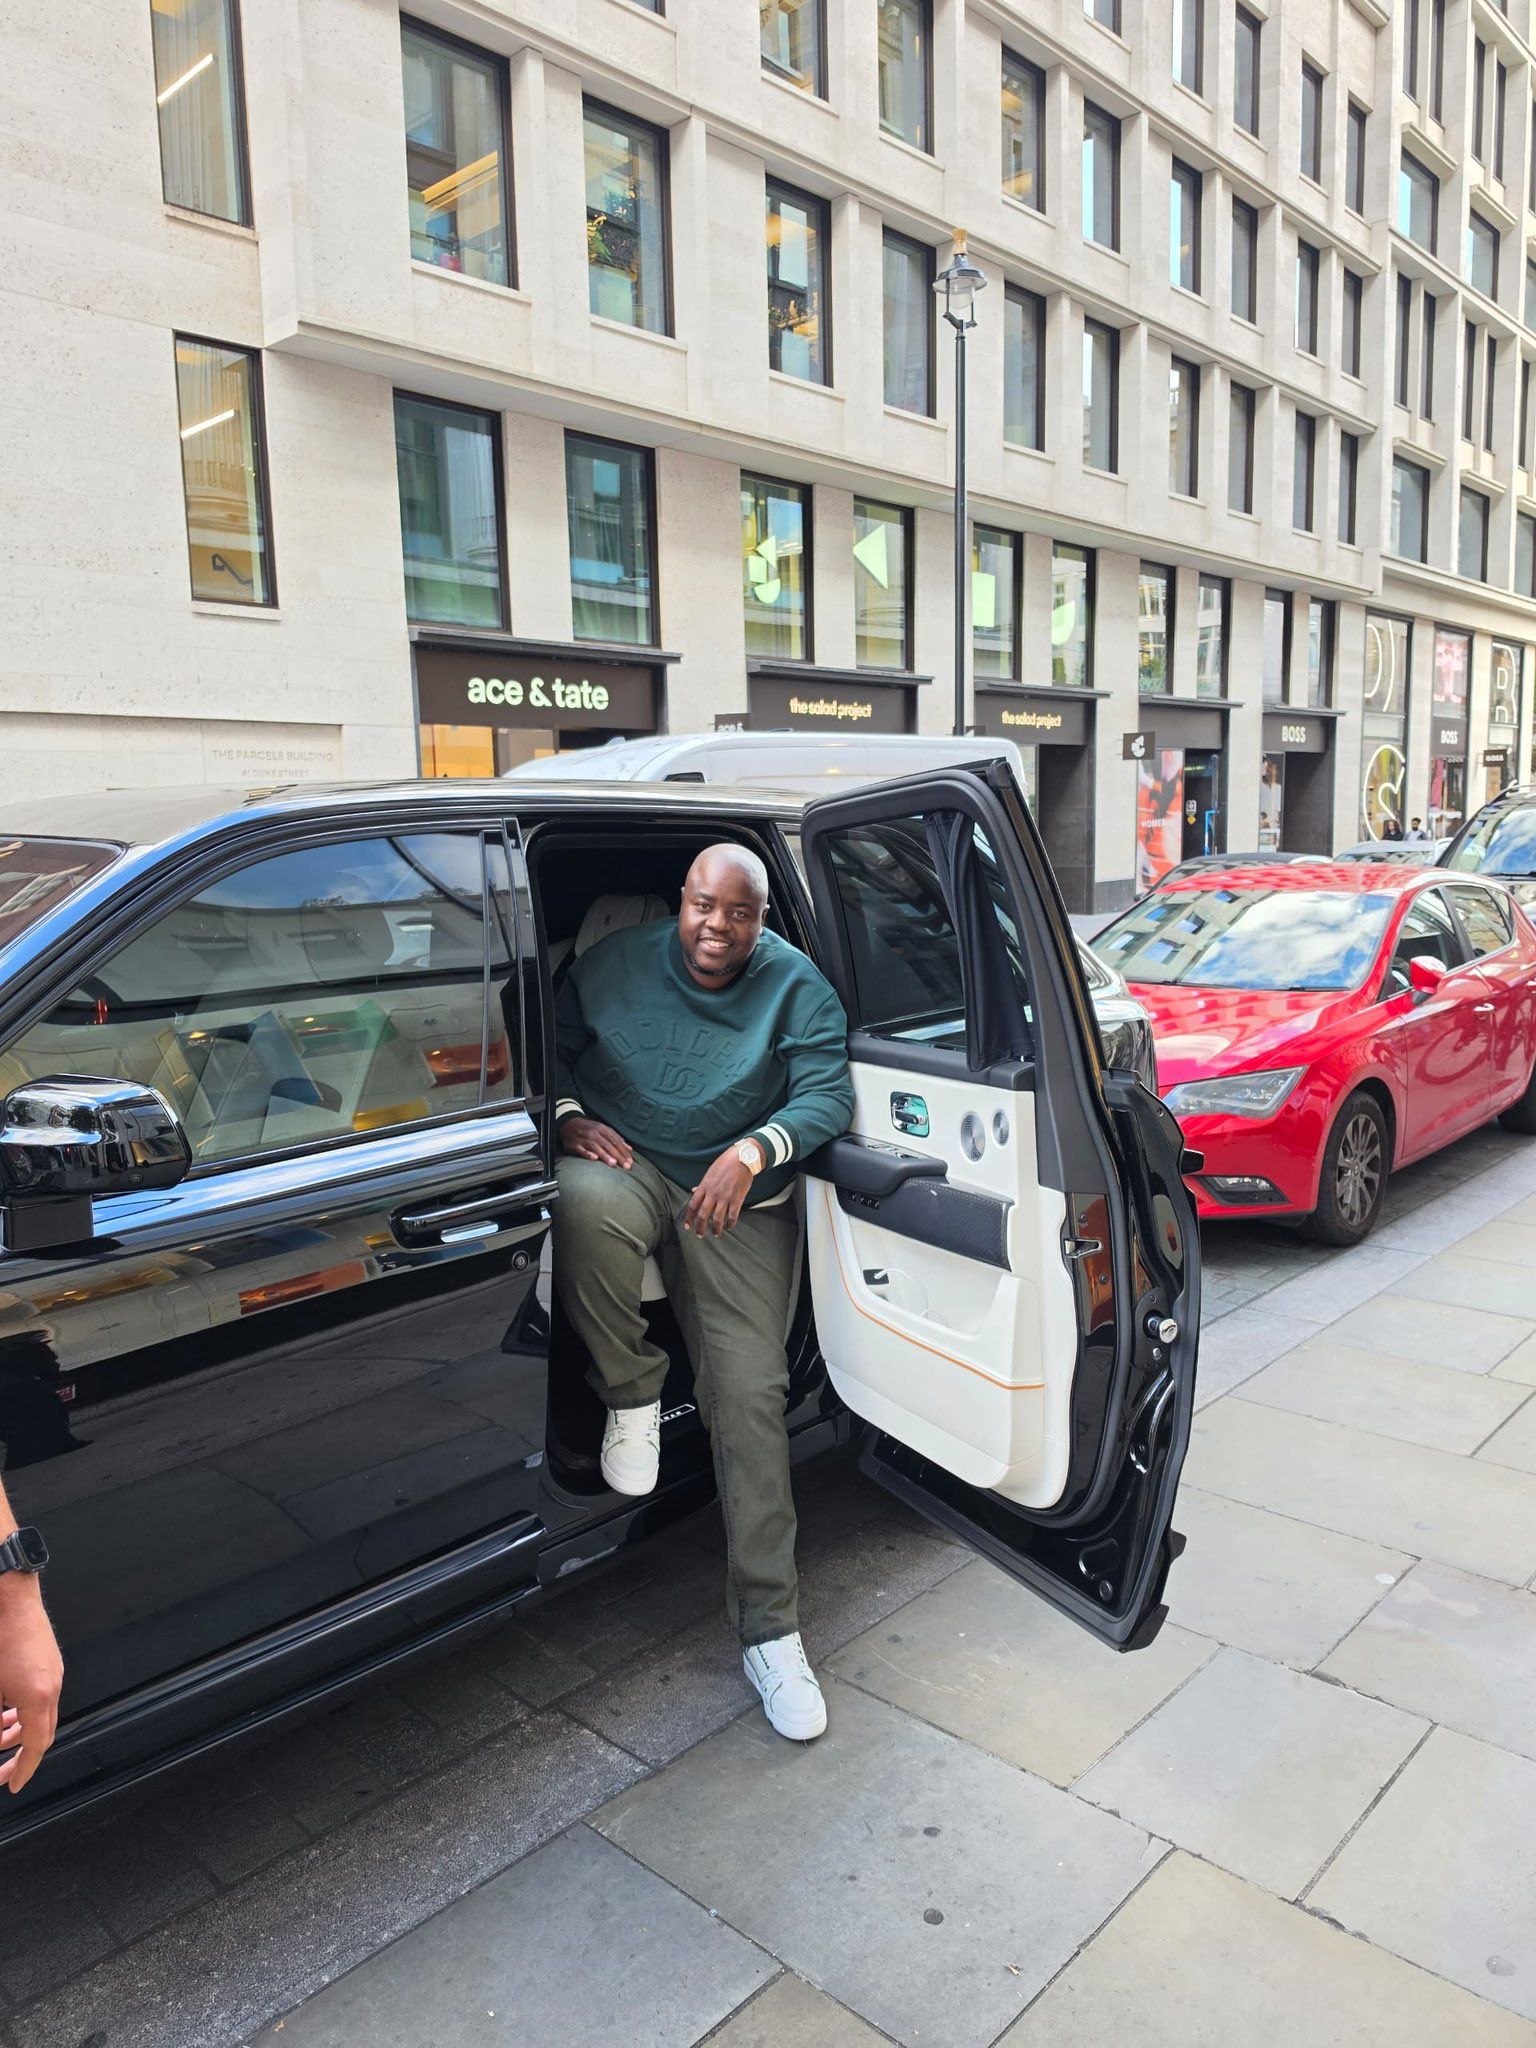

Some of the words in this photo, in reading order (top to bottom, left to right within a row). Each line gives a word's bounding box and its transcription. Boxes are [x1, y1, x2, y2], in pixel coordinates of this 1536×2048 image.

[467, 677, 524, 706] ace
[529, 676, 553, 707] &
[552, 677, 610, 711] tate
[789, 697, 808, 714] the
[808, 698, 838, 716] salad
[837, 701, 873, 720] project
[1001, 710, 1015, 725] the
[1015, 711, 1037, 726] salad
[1036, 713, 1062, 730] project
[1281, 725, 1306, 743] BOSS
[1440, 729, 1458, 745] BOSS
[212, 749, 233, 760] THE
[286, 751, 334, 762] BUILDING
